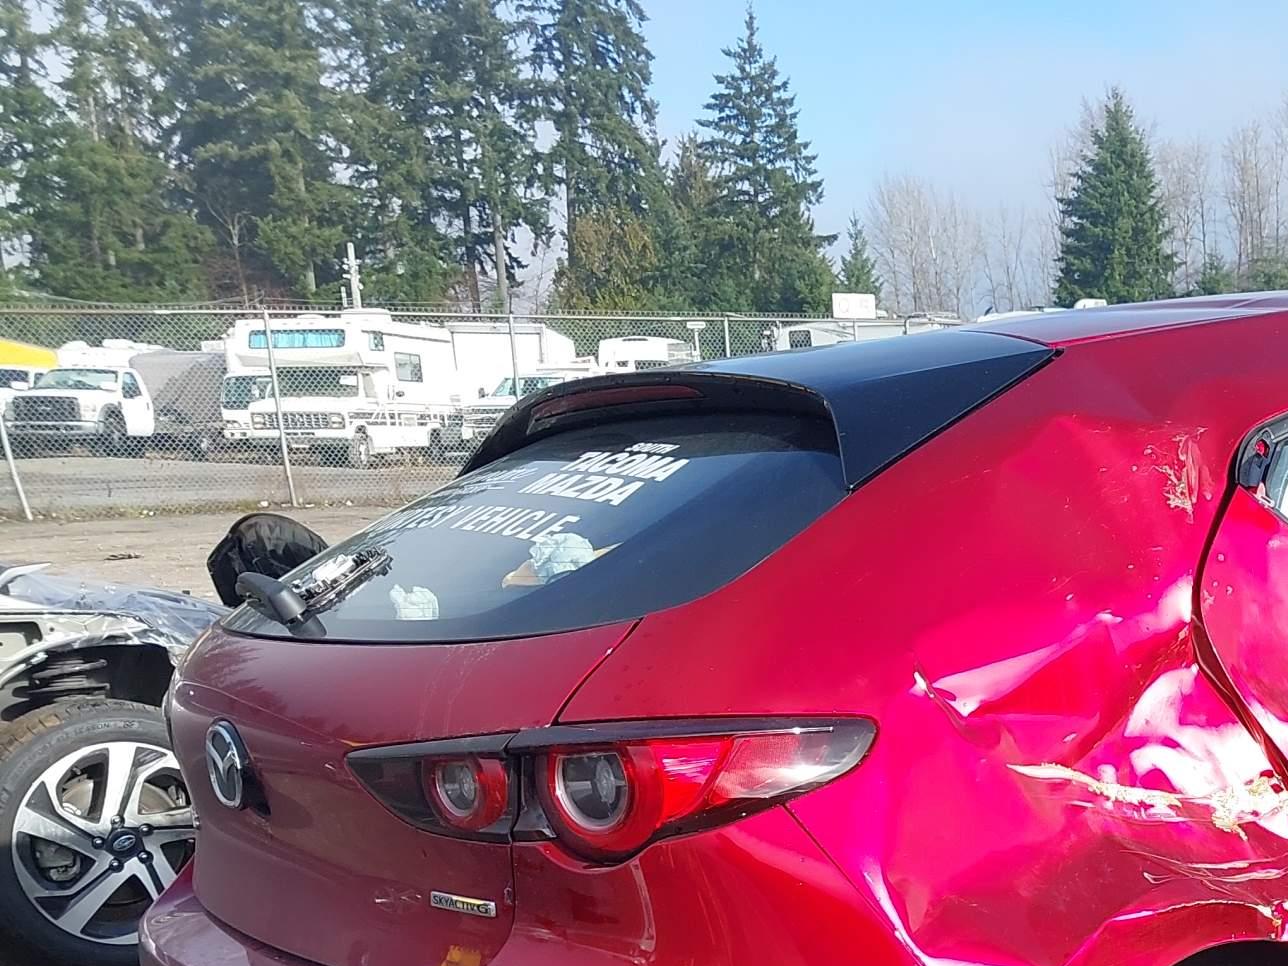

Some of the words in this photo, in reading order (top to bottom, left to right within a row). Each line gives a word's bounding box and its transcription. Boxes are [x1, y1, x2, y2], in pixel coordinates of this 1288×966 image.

[624, 442, 681, 454] SOUTH
[560, 451, 690, 482] TACOMA
[517, 473, 645, 506] MAZDA
[450, 505, 581, 543] VEHICLE
